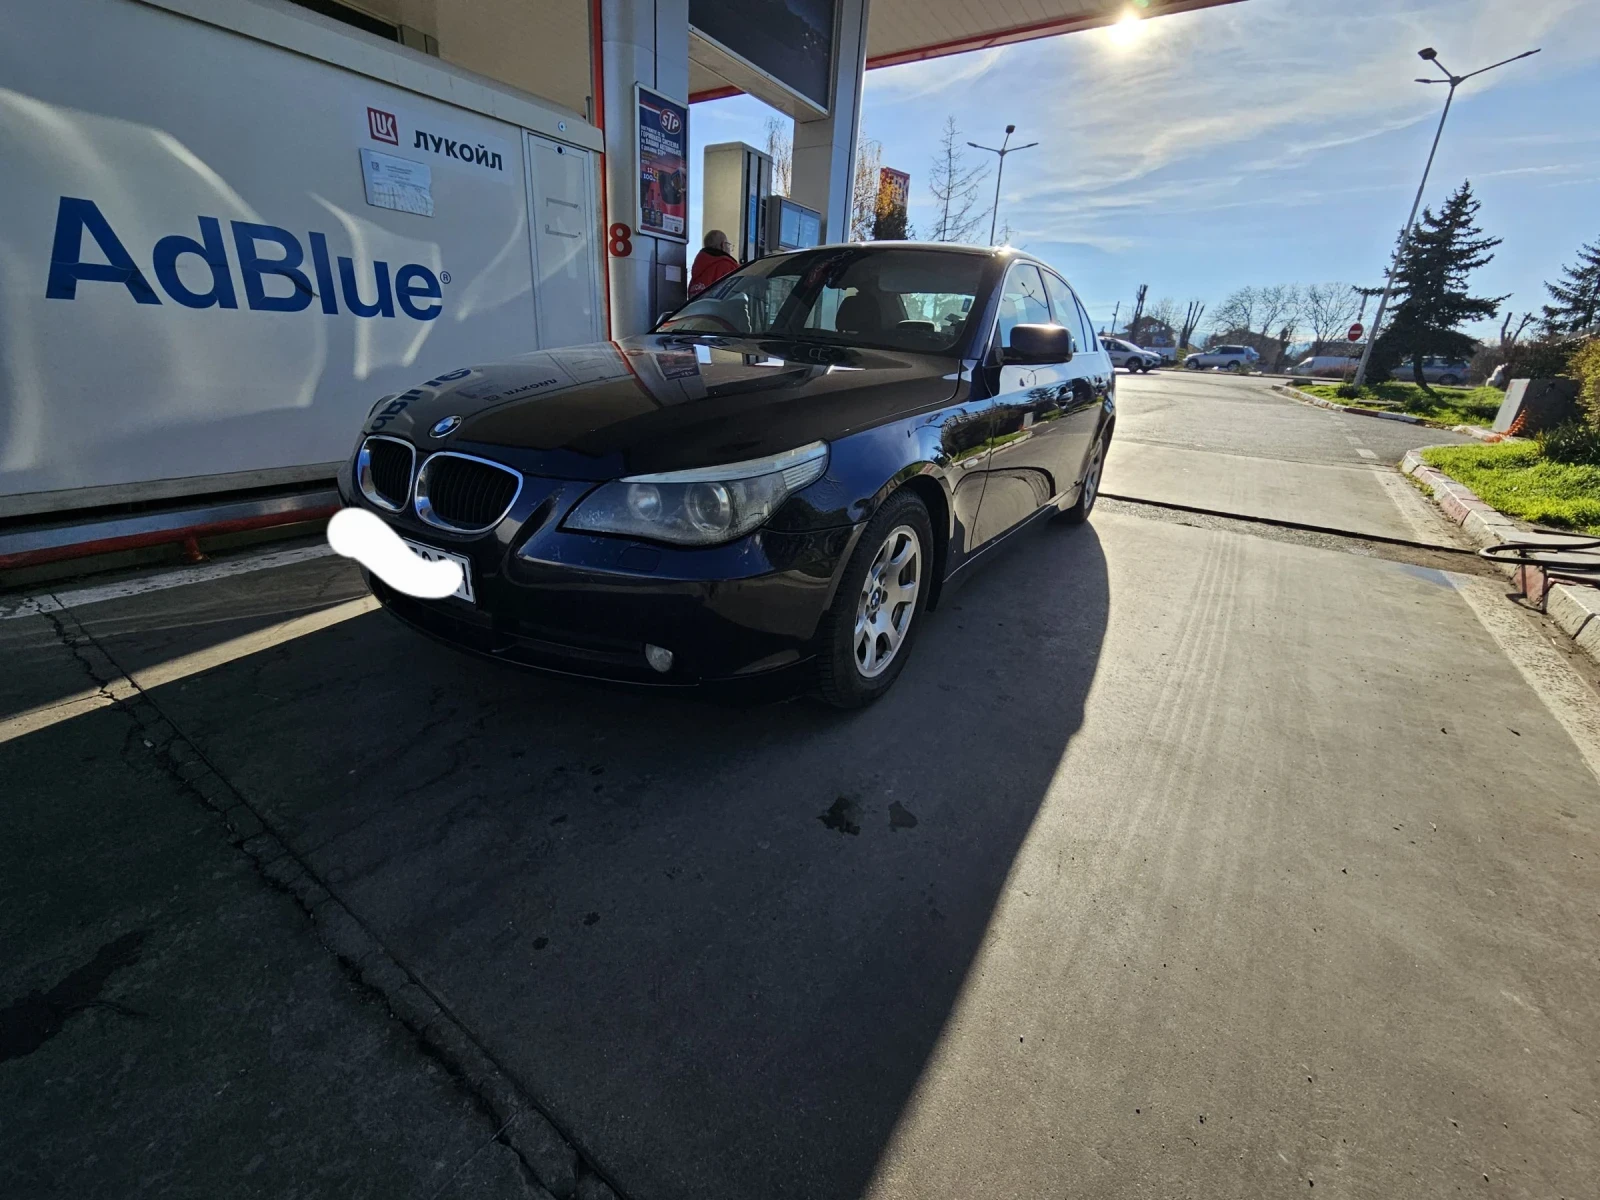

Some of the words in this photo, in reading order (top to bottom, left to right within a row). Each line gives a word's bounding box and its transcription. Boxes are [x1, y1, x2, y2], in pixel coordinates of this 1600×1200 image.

[661, 111, 680, 130] STP
[413, 129, 503, 171] ЛУКОЙЛ
[609, 222, 632, 257] 8
